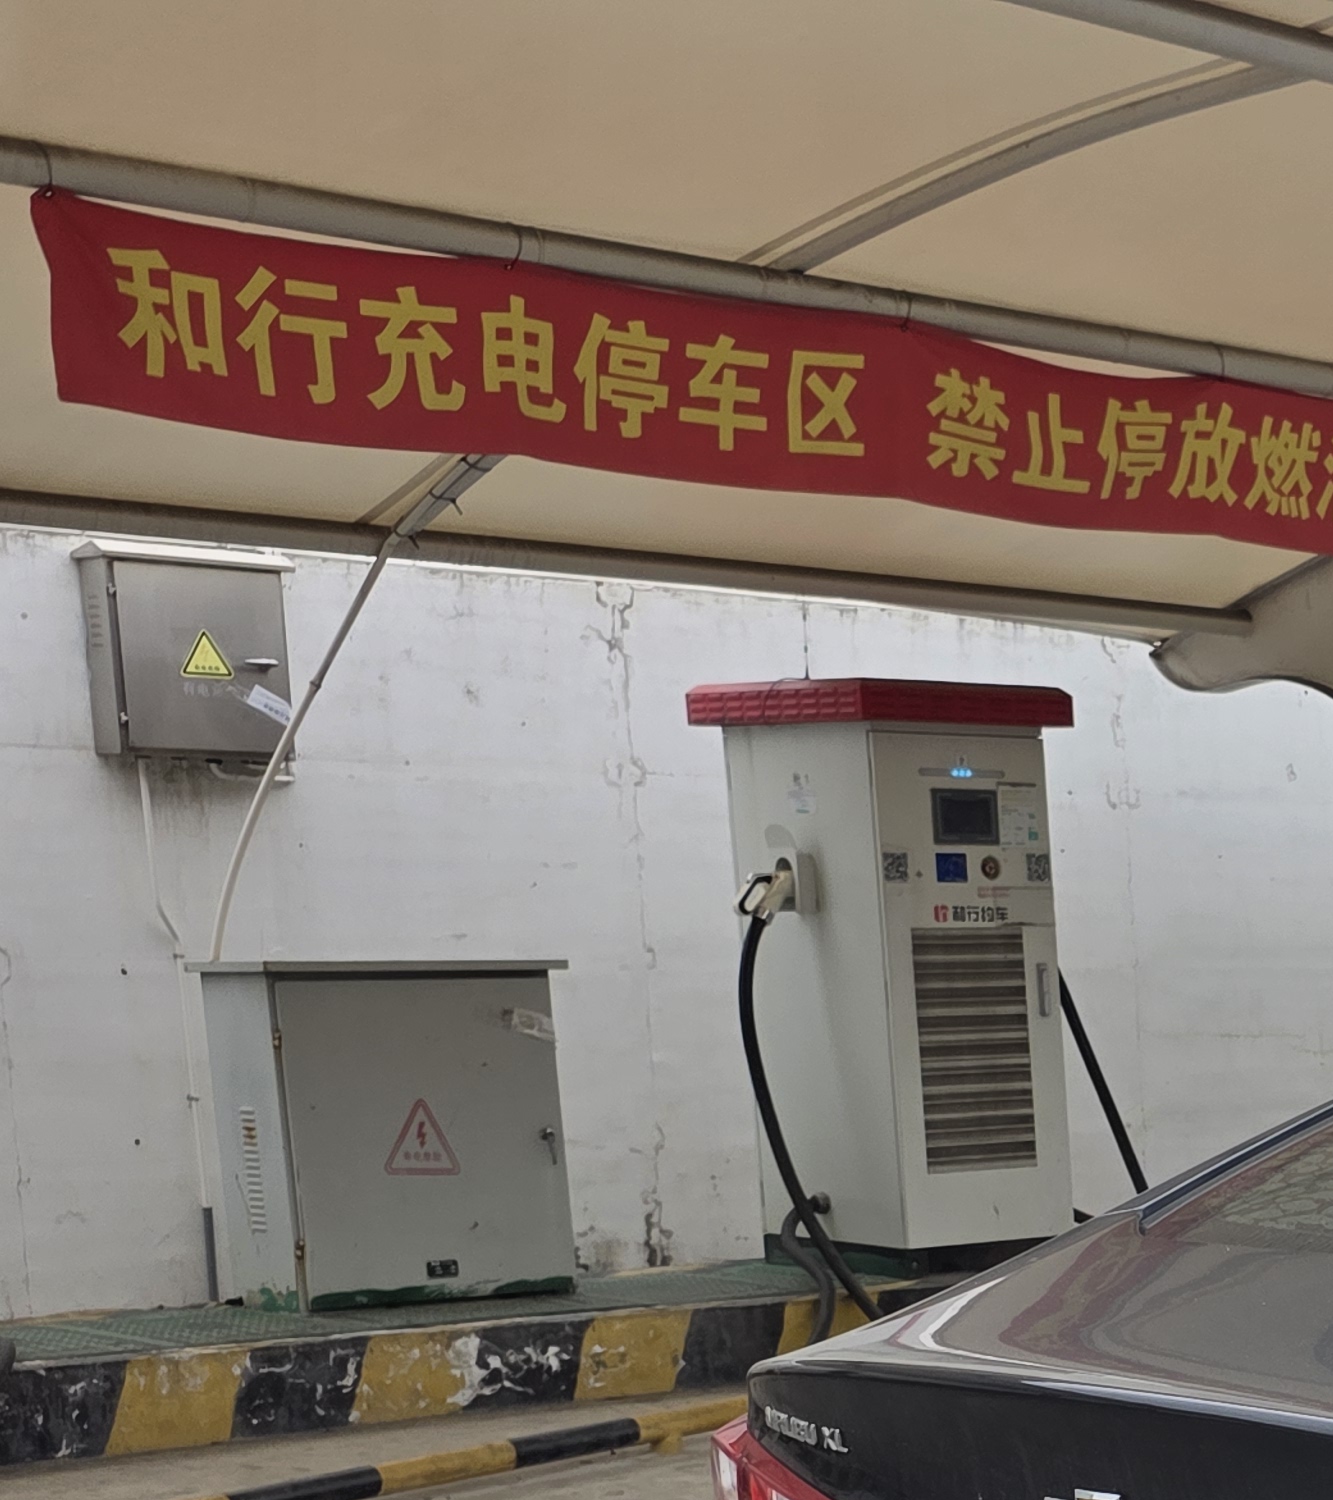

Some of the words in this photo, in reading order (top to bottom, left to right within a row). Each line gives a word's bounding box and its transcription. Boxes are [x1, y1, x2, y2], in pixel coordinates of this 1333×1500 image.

[107, 247, 865, 457] 和行充电停车区
[952, 905, 1009, 922] 和行约车
[820, 1426, 849, 1453] XL
